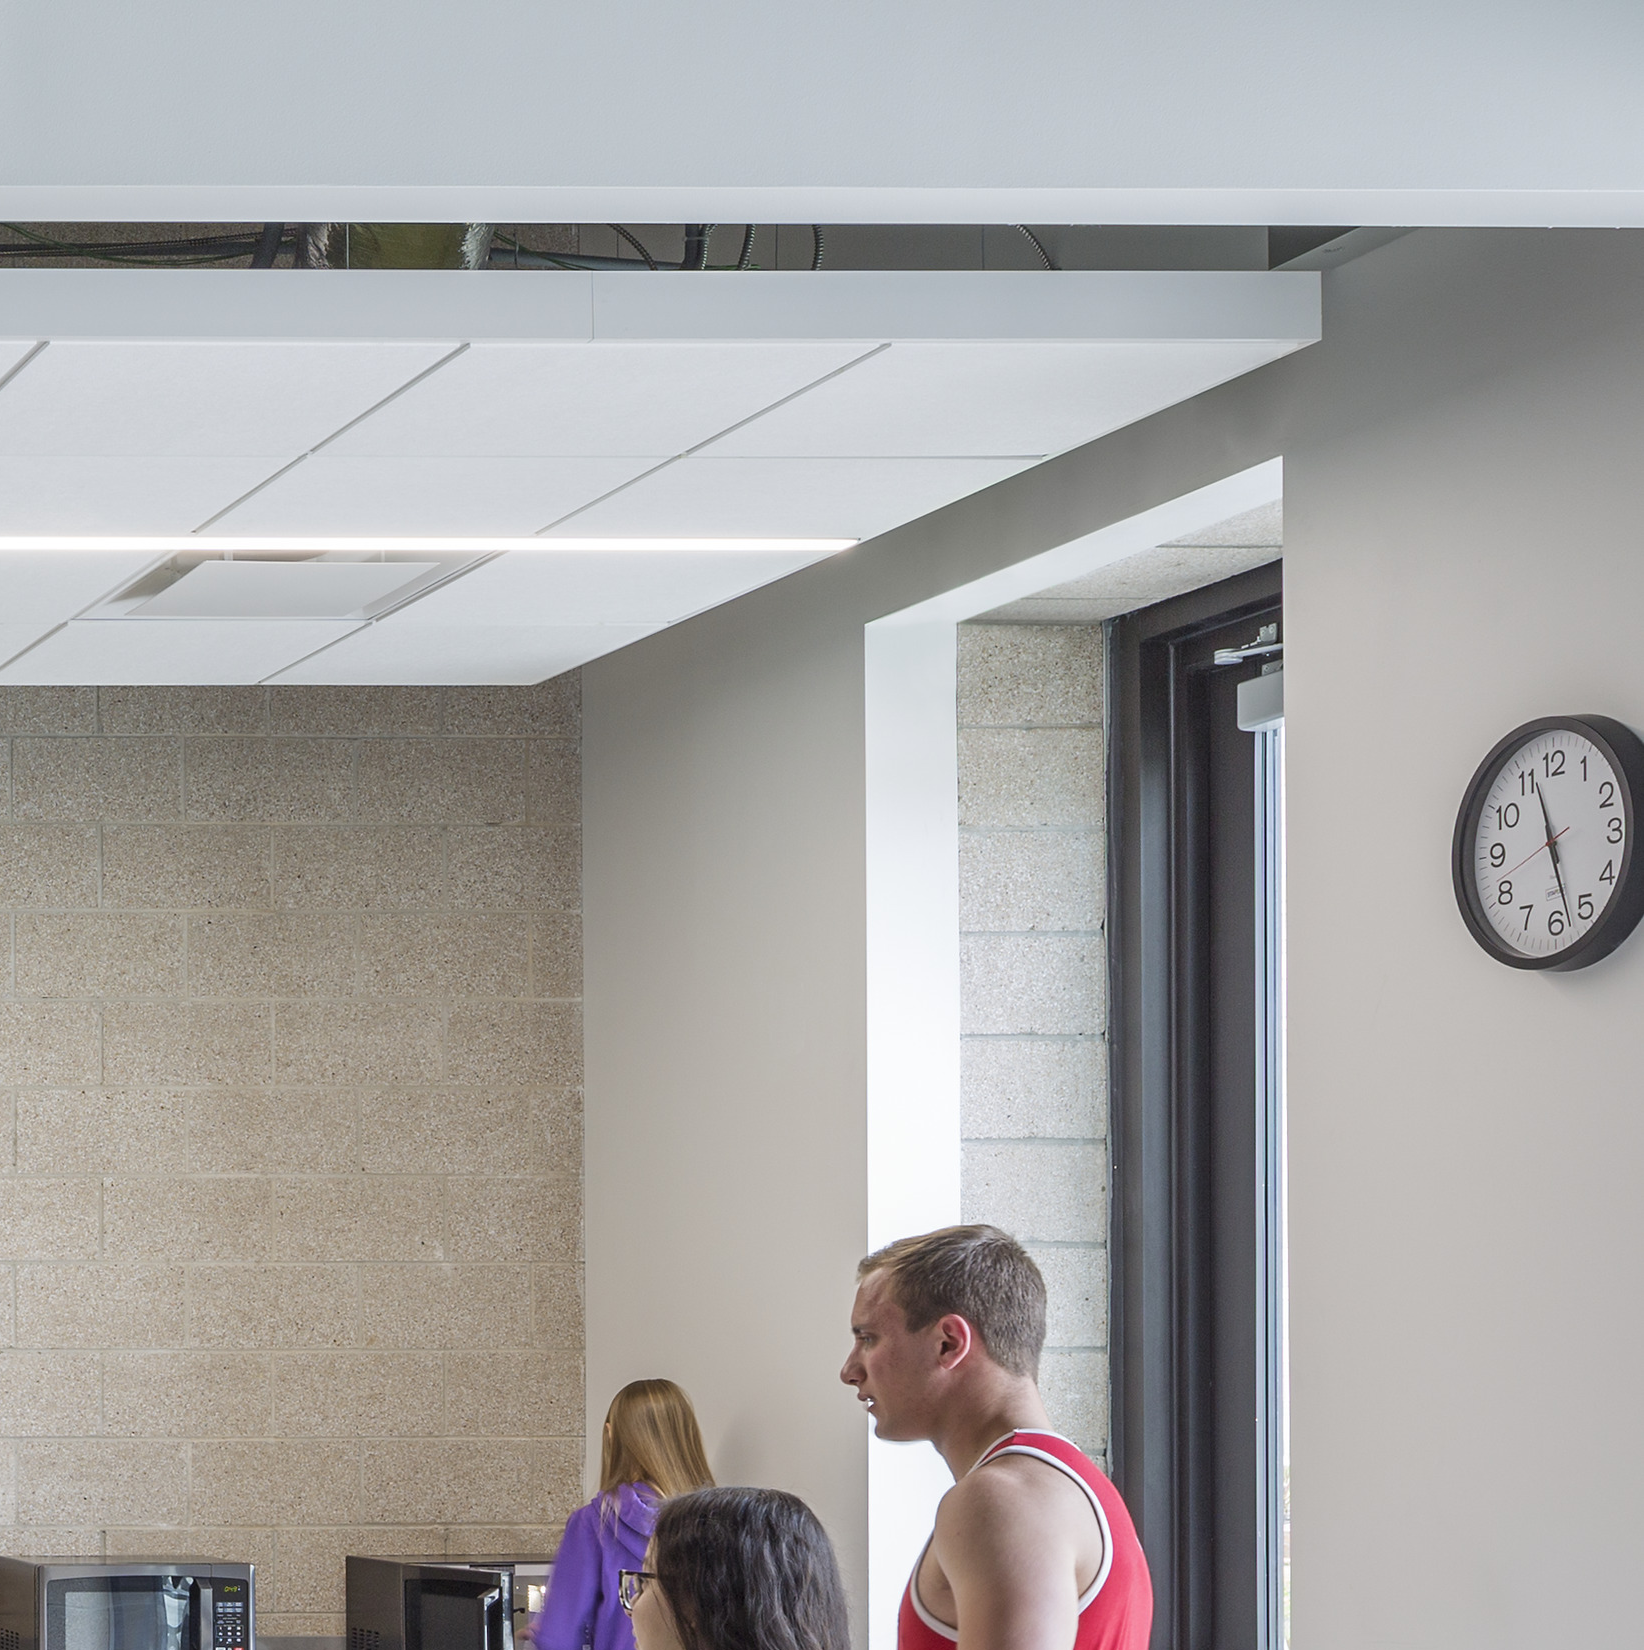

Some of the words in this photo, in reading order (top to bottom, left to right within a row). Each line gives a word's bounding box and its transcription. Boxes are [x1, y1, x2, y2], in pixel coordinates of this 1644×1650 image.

[1542, 749, 1566, 778] 12
[1580, 755, 1587, 782] 1
[1518, 768, 1535, 796] 11
[1598, 781, 1615, 809] 2
[1496, 802, 1520, 830] 10
[1606, 817, 1623, 844] 3
[1489, 842, 1506, 868] 9
[1599, 859, 1616, 886] 4
[1498, 880, 1513, 905] 8
[1519, 904, 1534, 931] 7
[1577, 893, 1594, 920] 5
[1547, 910, 1565, 936] 6
